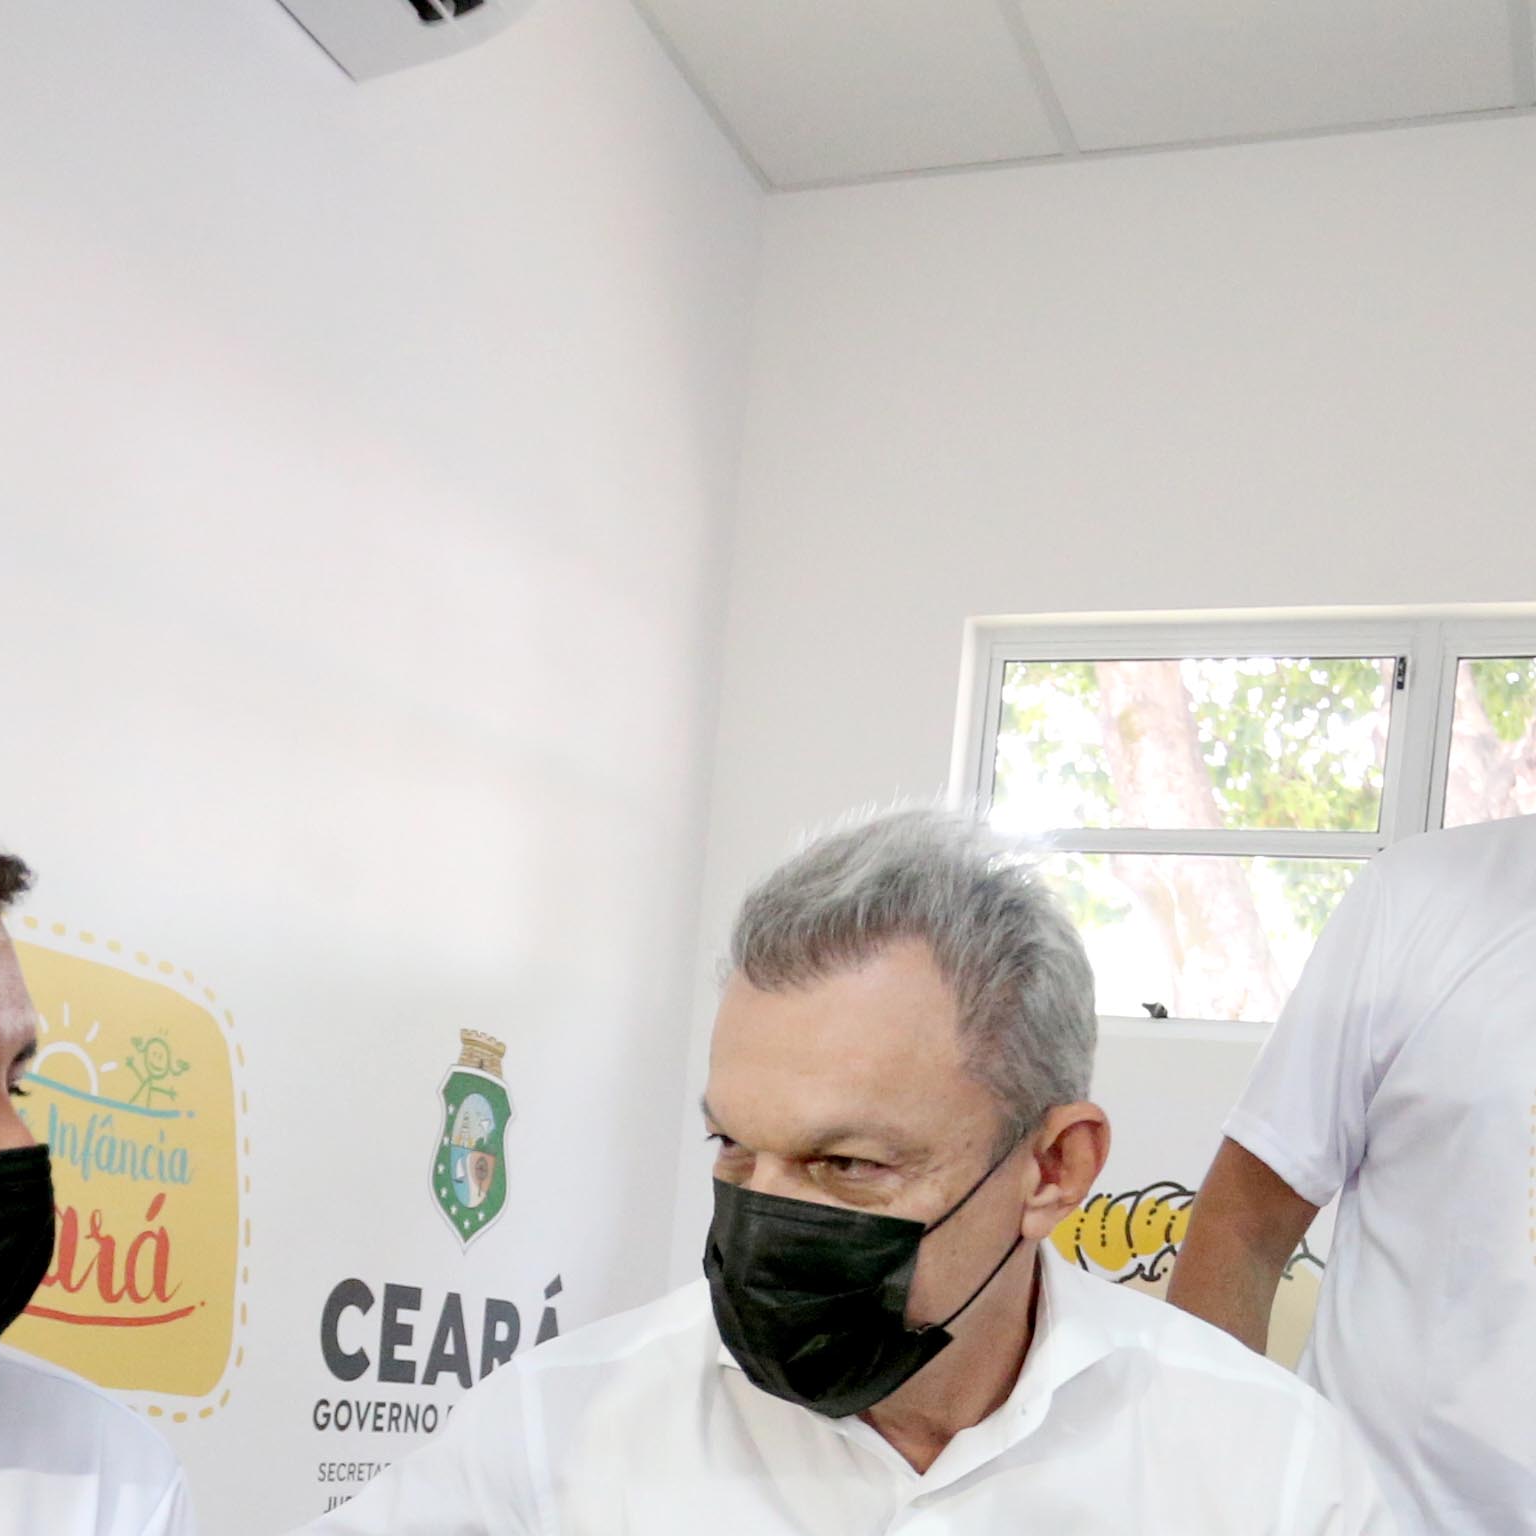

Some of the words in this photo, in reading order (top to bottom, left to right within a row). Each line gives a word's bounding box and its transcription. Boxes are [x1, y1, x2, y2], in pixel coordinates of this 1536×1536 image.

[49, 1103, 192, 1184] Infância
[41, 1192, 182, 1304] ará
[312, 1398, 438, 1433] GOVERNO
[317, 1462, 392, 1482] SECRETA
[323, 1495, 352, 1514] JU
